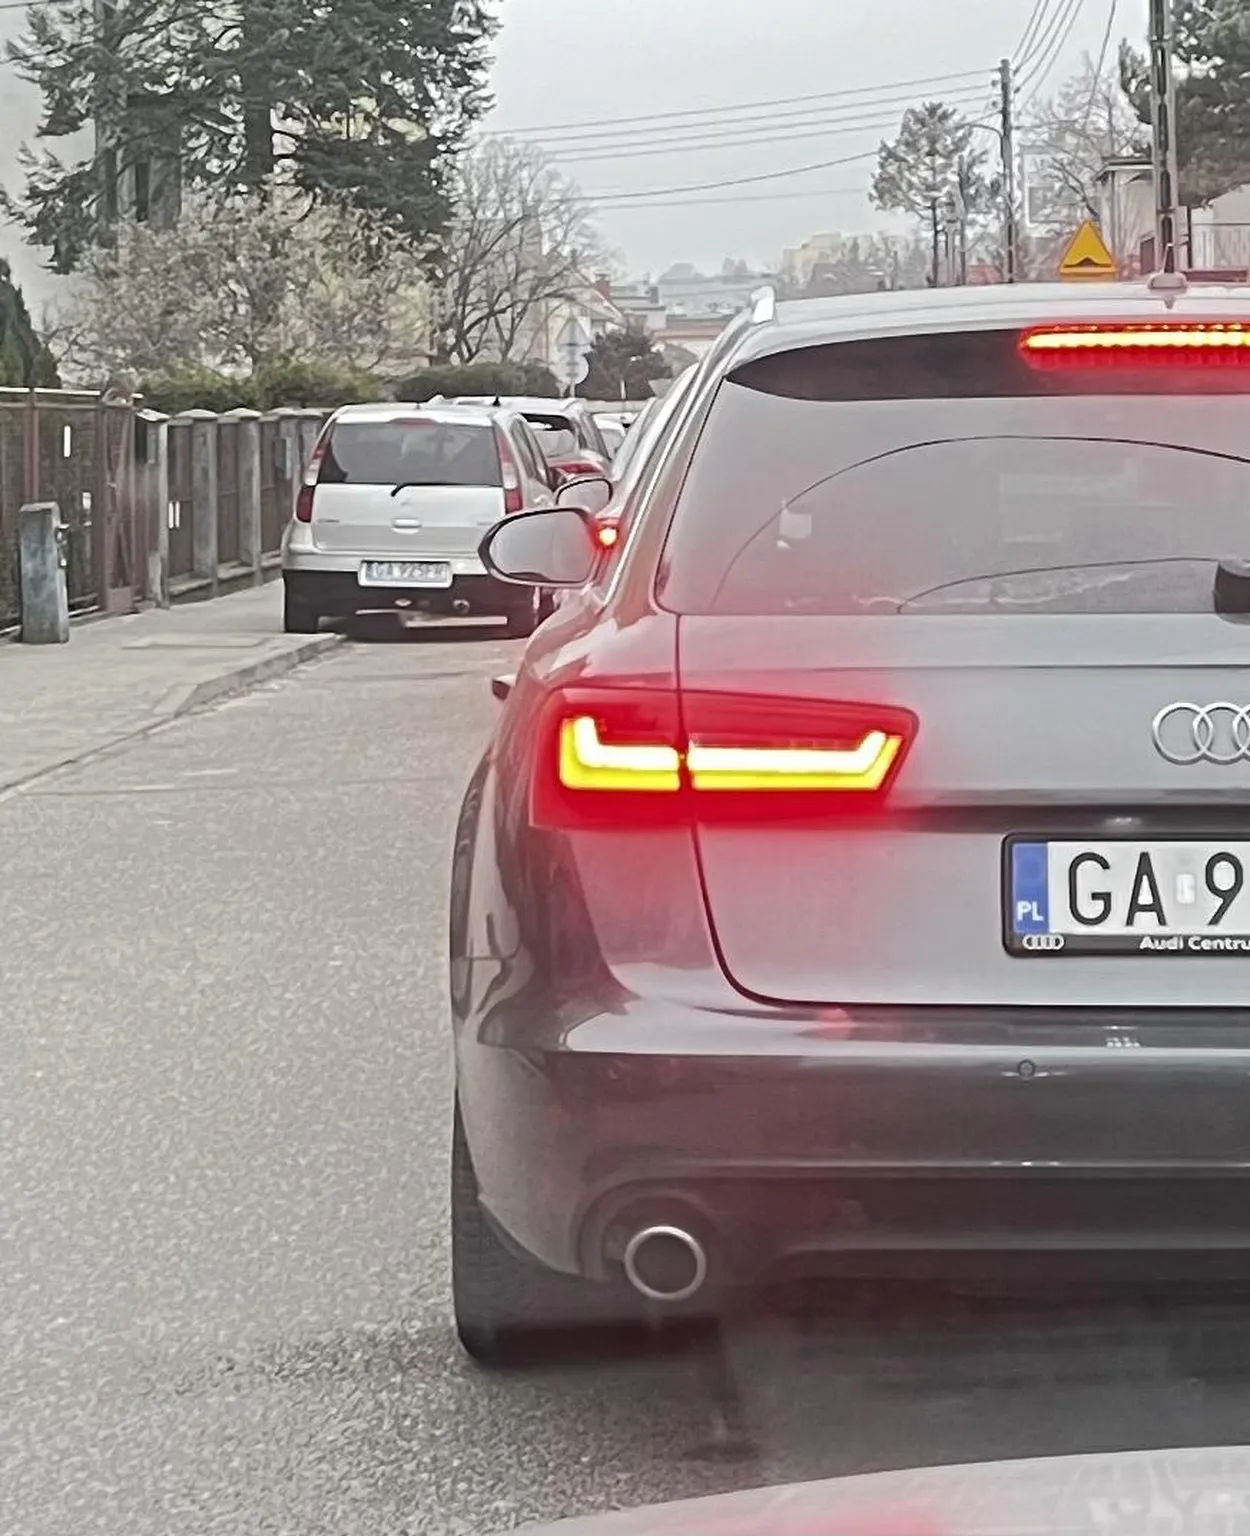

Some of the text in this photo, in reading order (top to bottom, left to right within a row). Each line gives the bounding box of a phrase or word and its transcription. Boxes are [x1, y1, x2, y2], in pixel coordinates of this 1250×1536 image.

[1068, 852, 1167, 926] GA
[1016, 901, 1044, 922] PL
[1139, 936, 1184, 950] Audi
